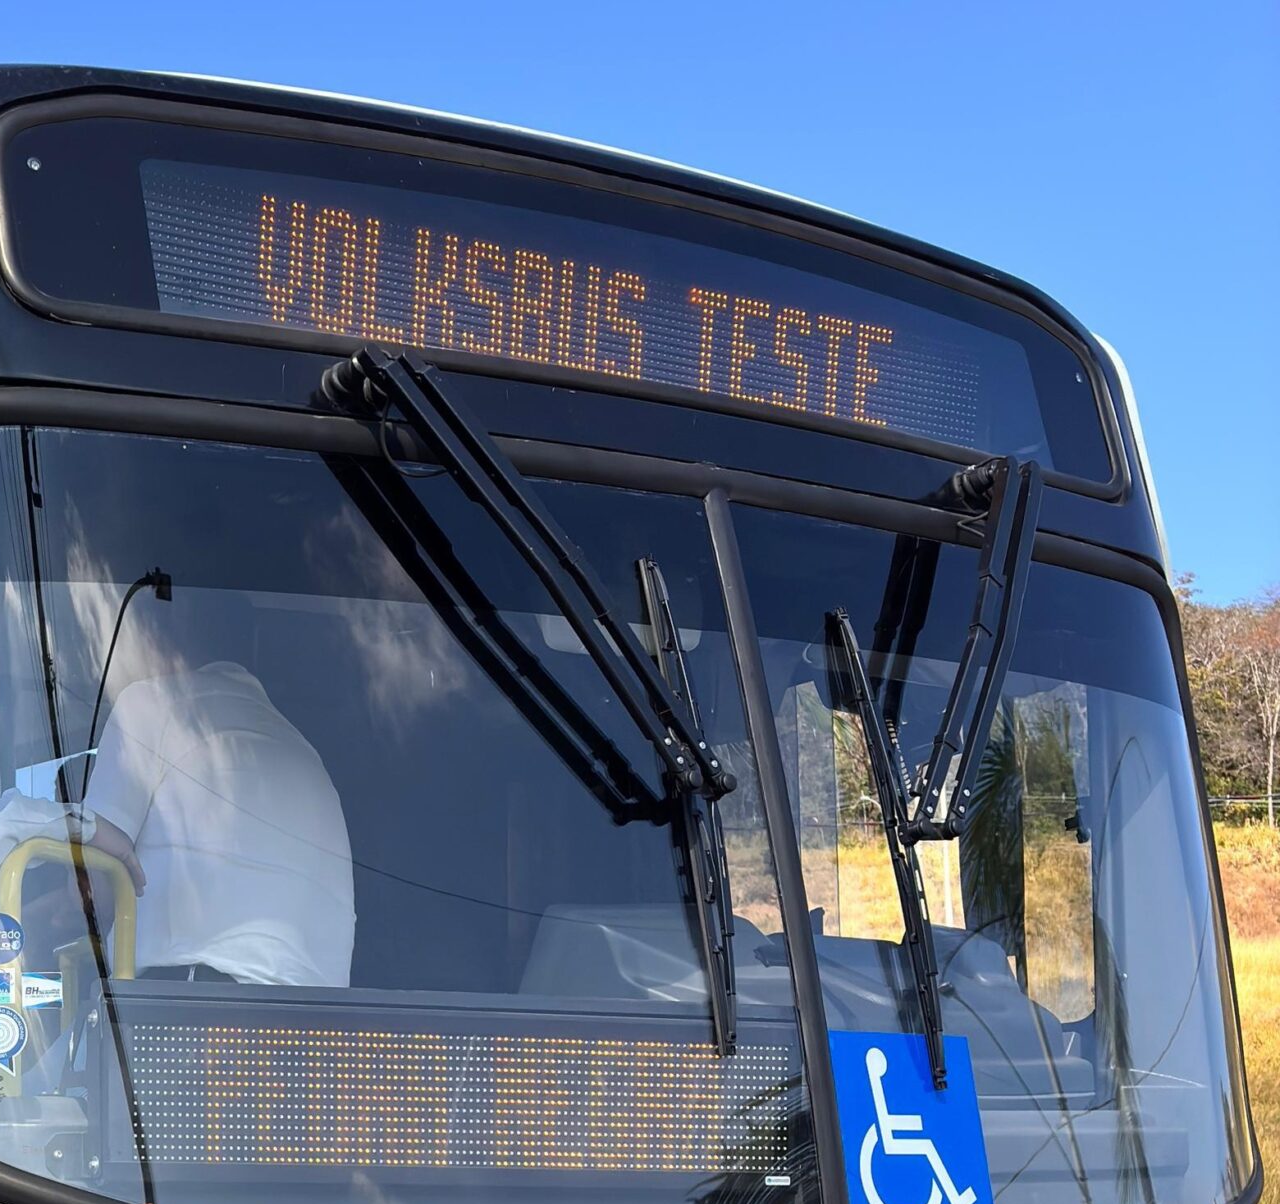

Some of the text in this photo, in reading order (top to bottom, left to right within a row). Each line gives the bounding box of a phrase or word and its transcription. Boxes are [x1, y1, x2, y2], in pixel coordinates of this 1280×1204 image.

[259, 192, 895, 428] VOLKSBUS TESTE
[25, 986, 39, 995] BH
